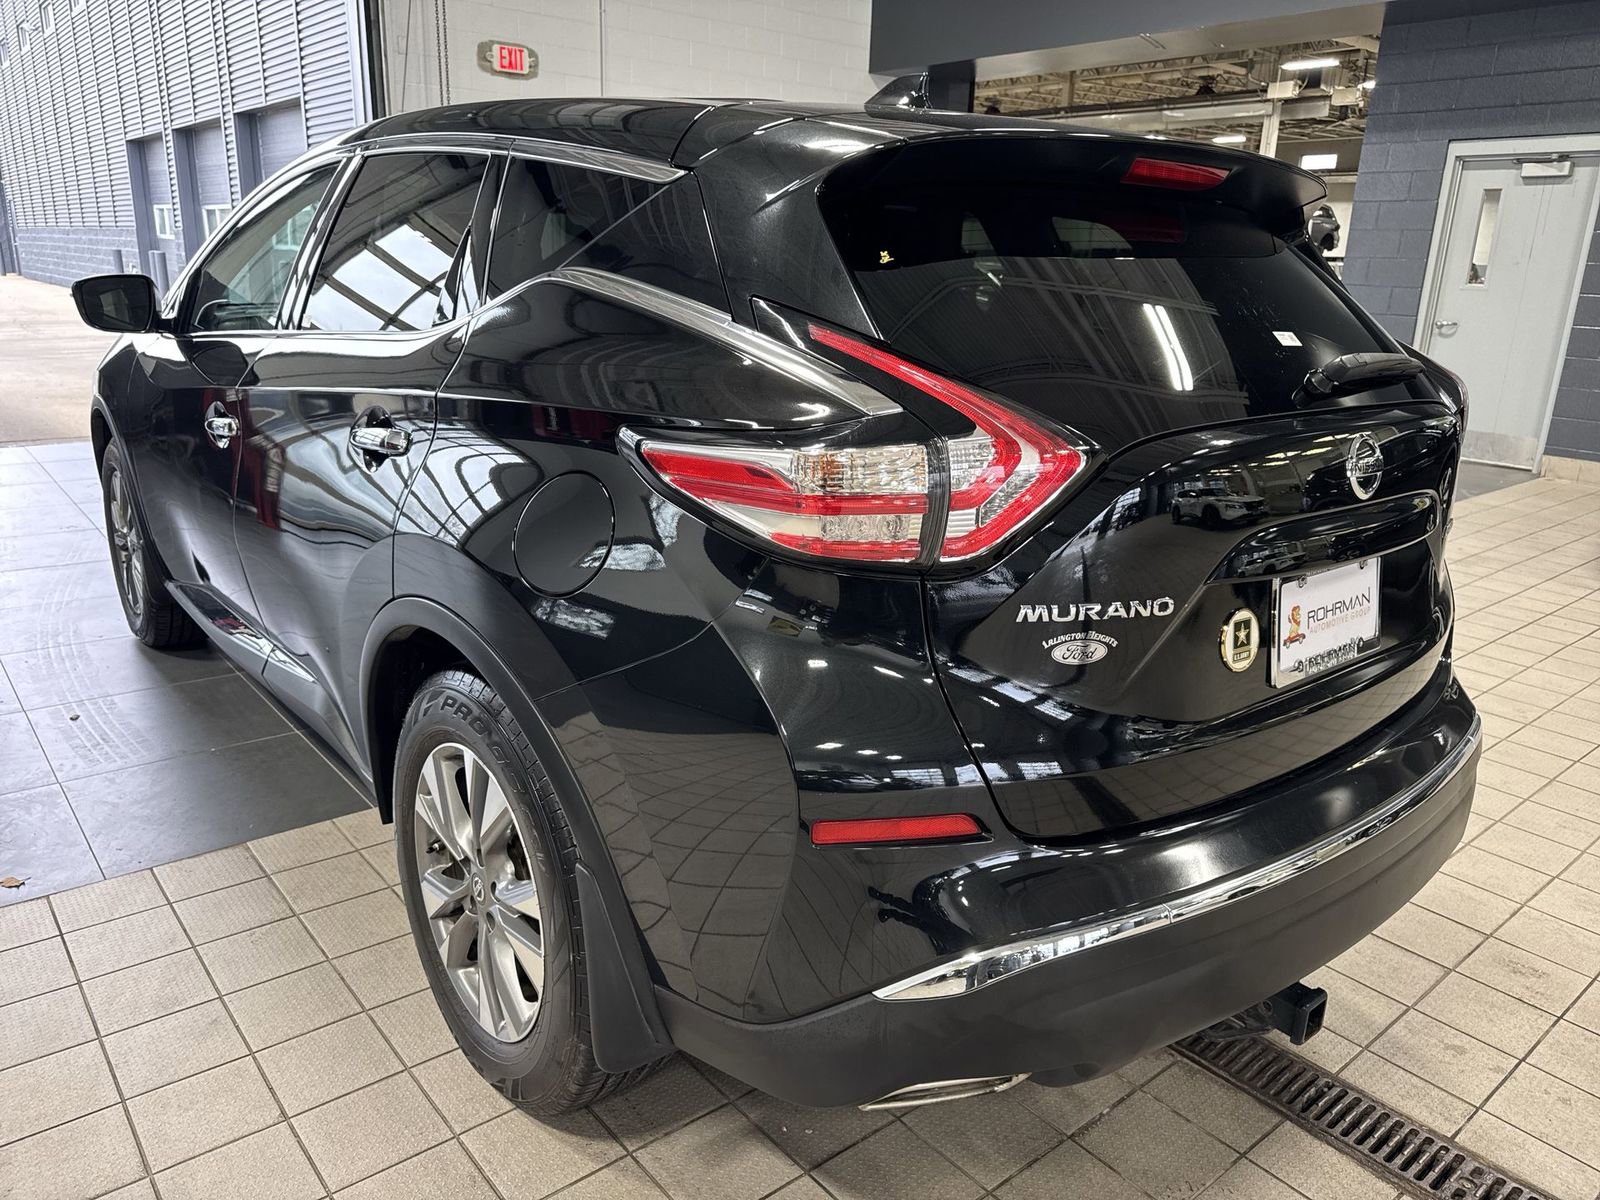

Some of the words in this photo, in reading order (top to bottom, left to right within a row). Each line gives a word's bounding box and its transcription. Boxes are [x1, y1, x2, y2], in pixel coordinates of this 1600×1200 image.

[499, 46, 524, 71] EXIT
[1016, 597, 1175, 623] MURANO
[1307, 587, 1371, 629] ROHRMAN
[1309, 616, 1348, 634] AUTOMOTIVE
[1350, 606, 1371, 619] GROUP
